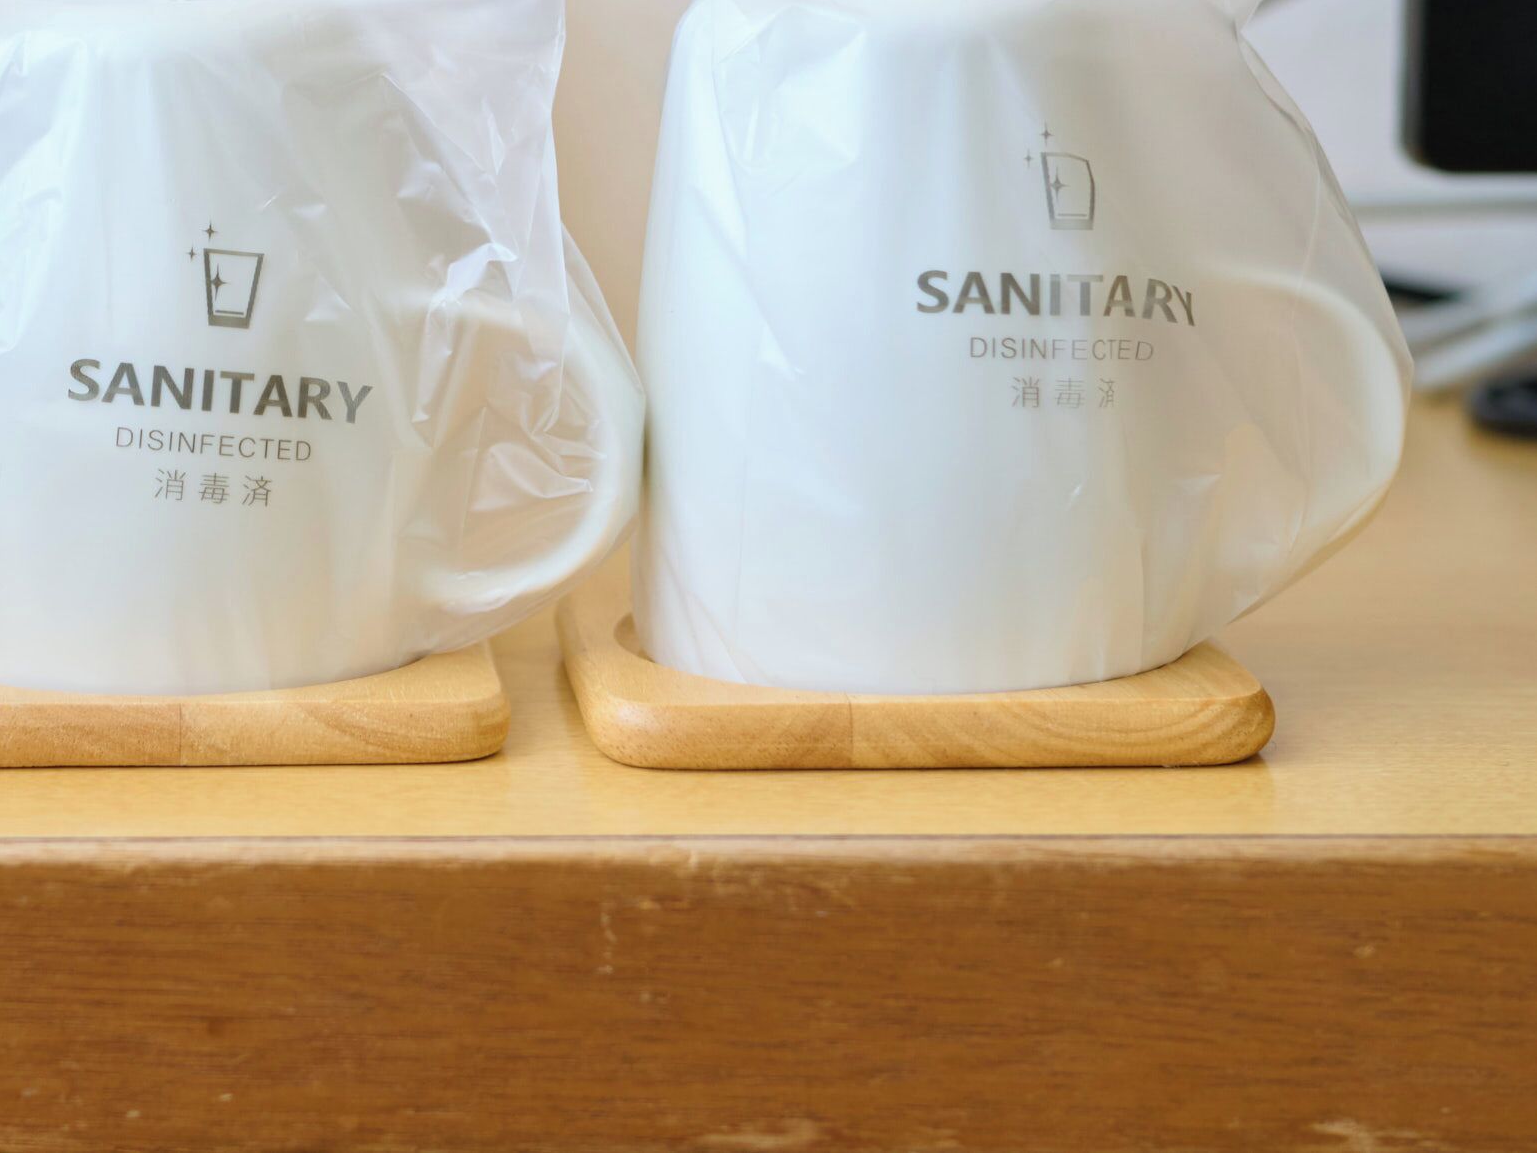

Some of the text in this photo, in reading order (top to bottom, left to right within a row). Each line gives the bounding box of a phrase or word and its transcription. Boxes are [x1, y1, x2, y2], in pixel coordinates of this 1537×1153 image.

[916, 270, 1196, 327] SANITARY
[969, 336, 1155, 361] DISINFECTED
[68, 358, 374, 424] SANITARY
[115, 427, 312, 461] DISINFECTED
[154, 469, 273, 507] 消毒済
